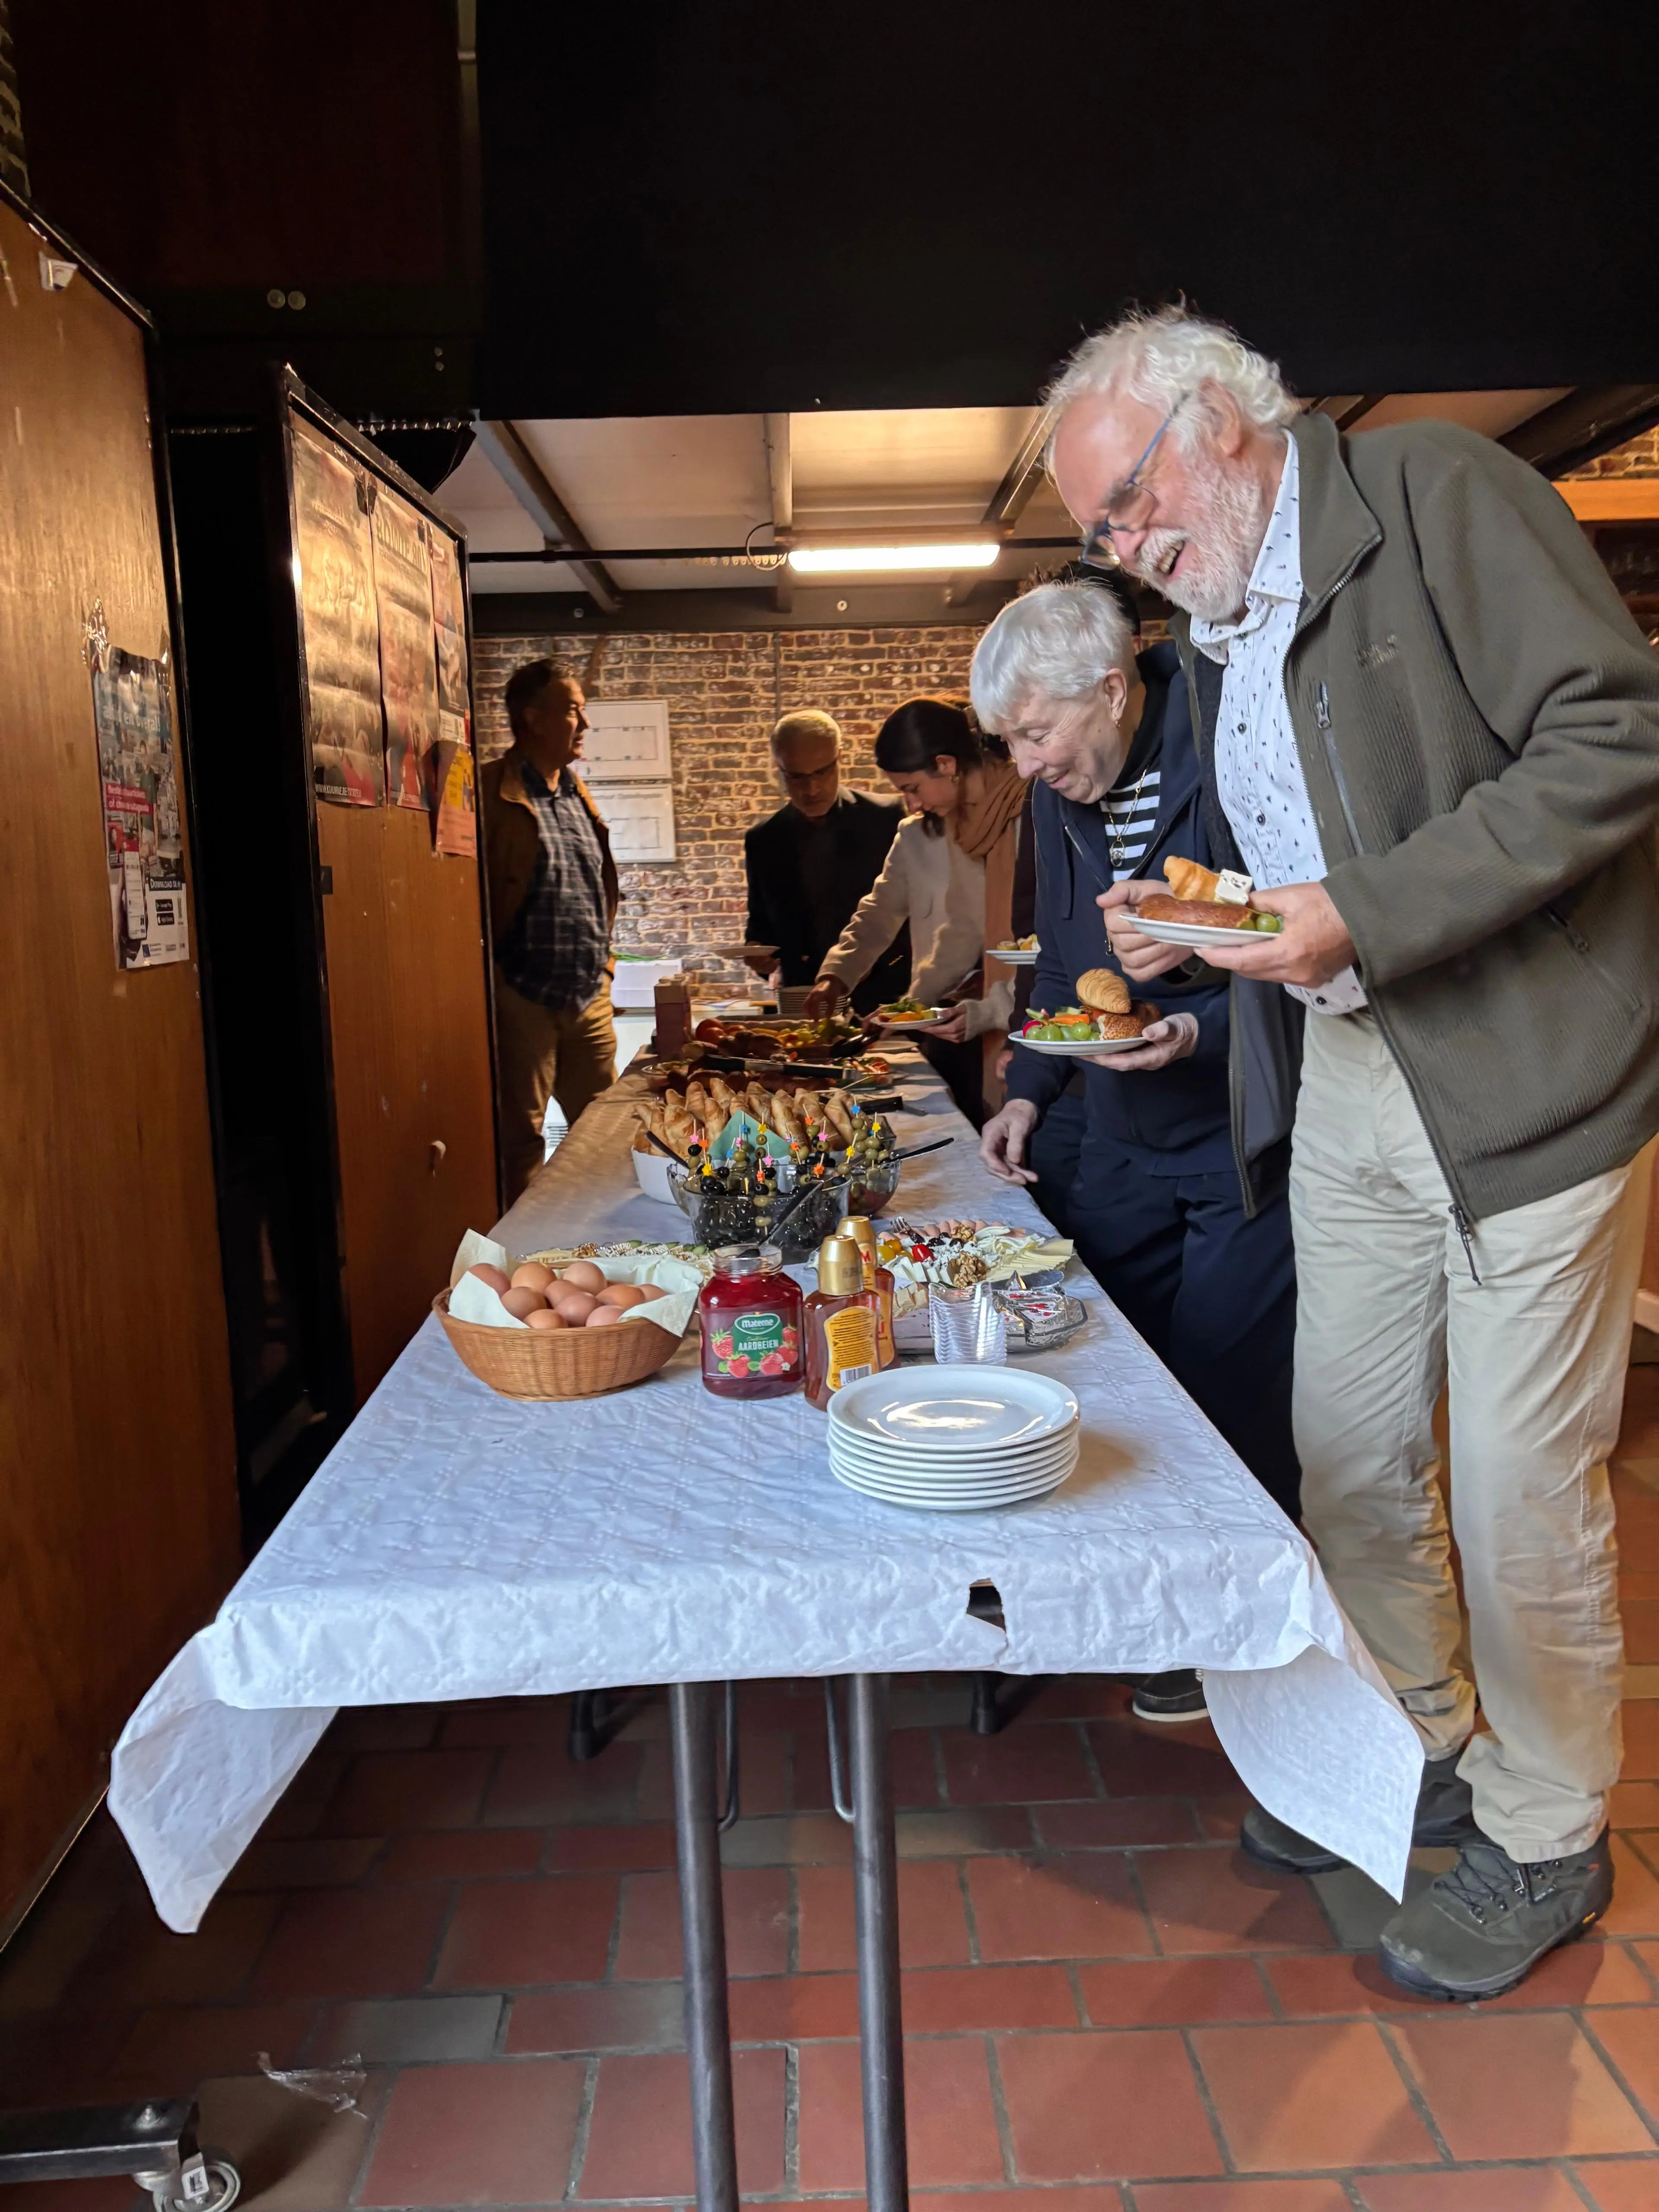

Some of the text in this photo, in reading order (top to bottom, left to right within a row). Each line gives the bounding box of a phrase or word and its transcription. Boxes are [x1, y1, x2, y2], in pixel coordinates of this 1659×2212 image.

[150, 878, 172, 889] DOWNLOAD
[741, 1319, 774, 1328] Materne
[738, 1339, 779, 1351] AARDBEIEN
